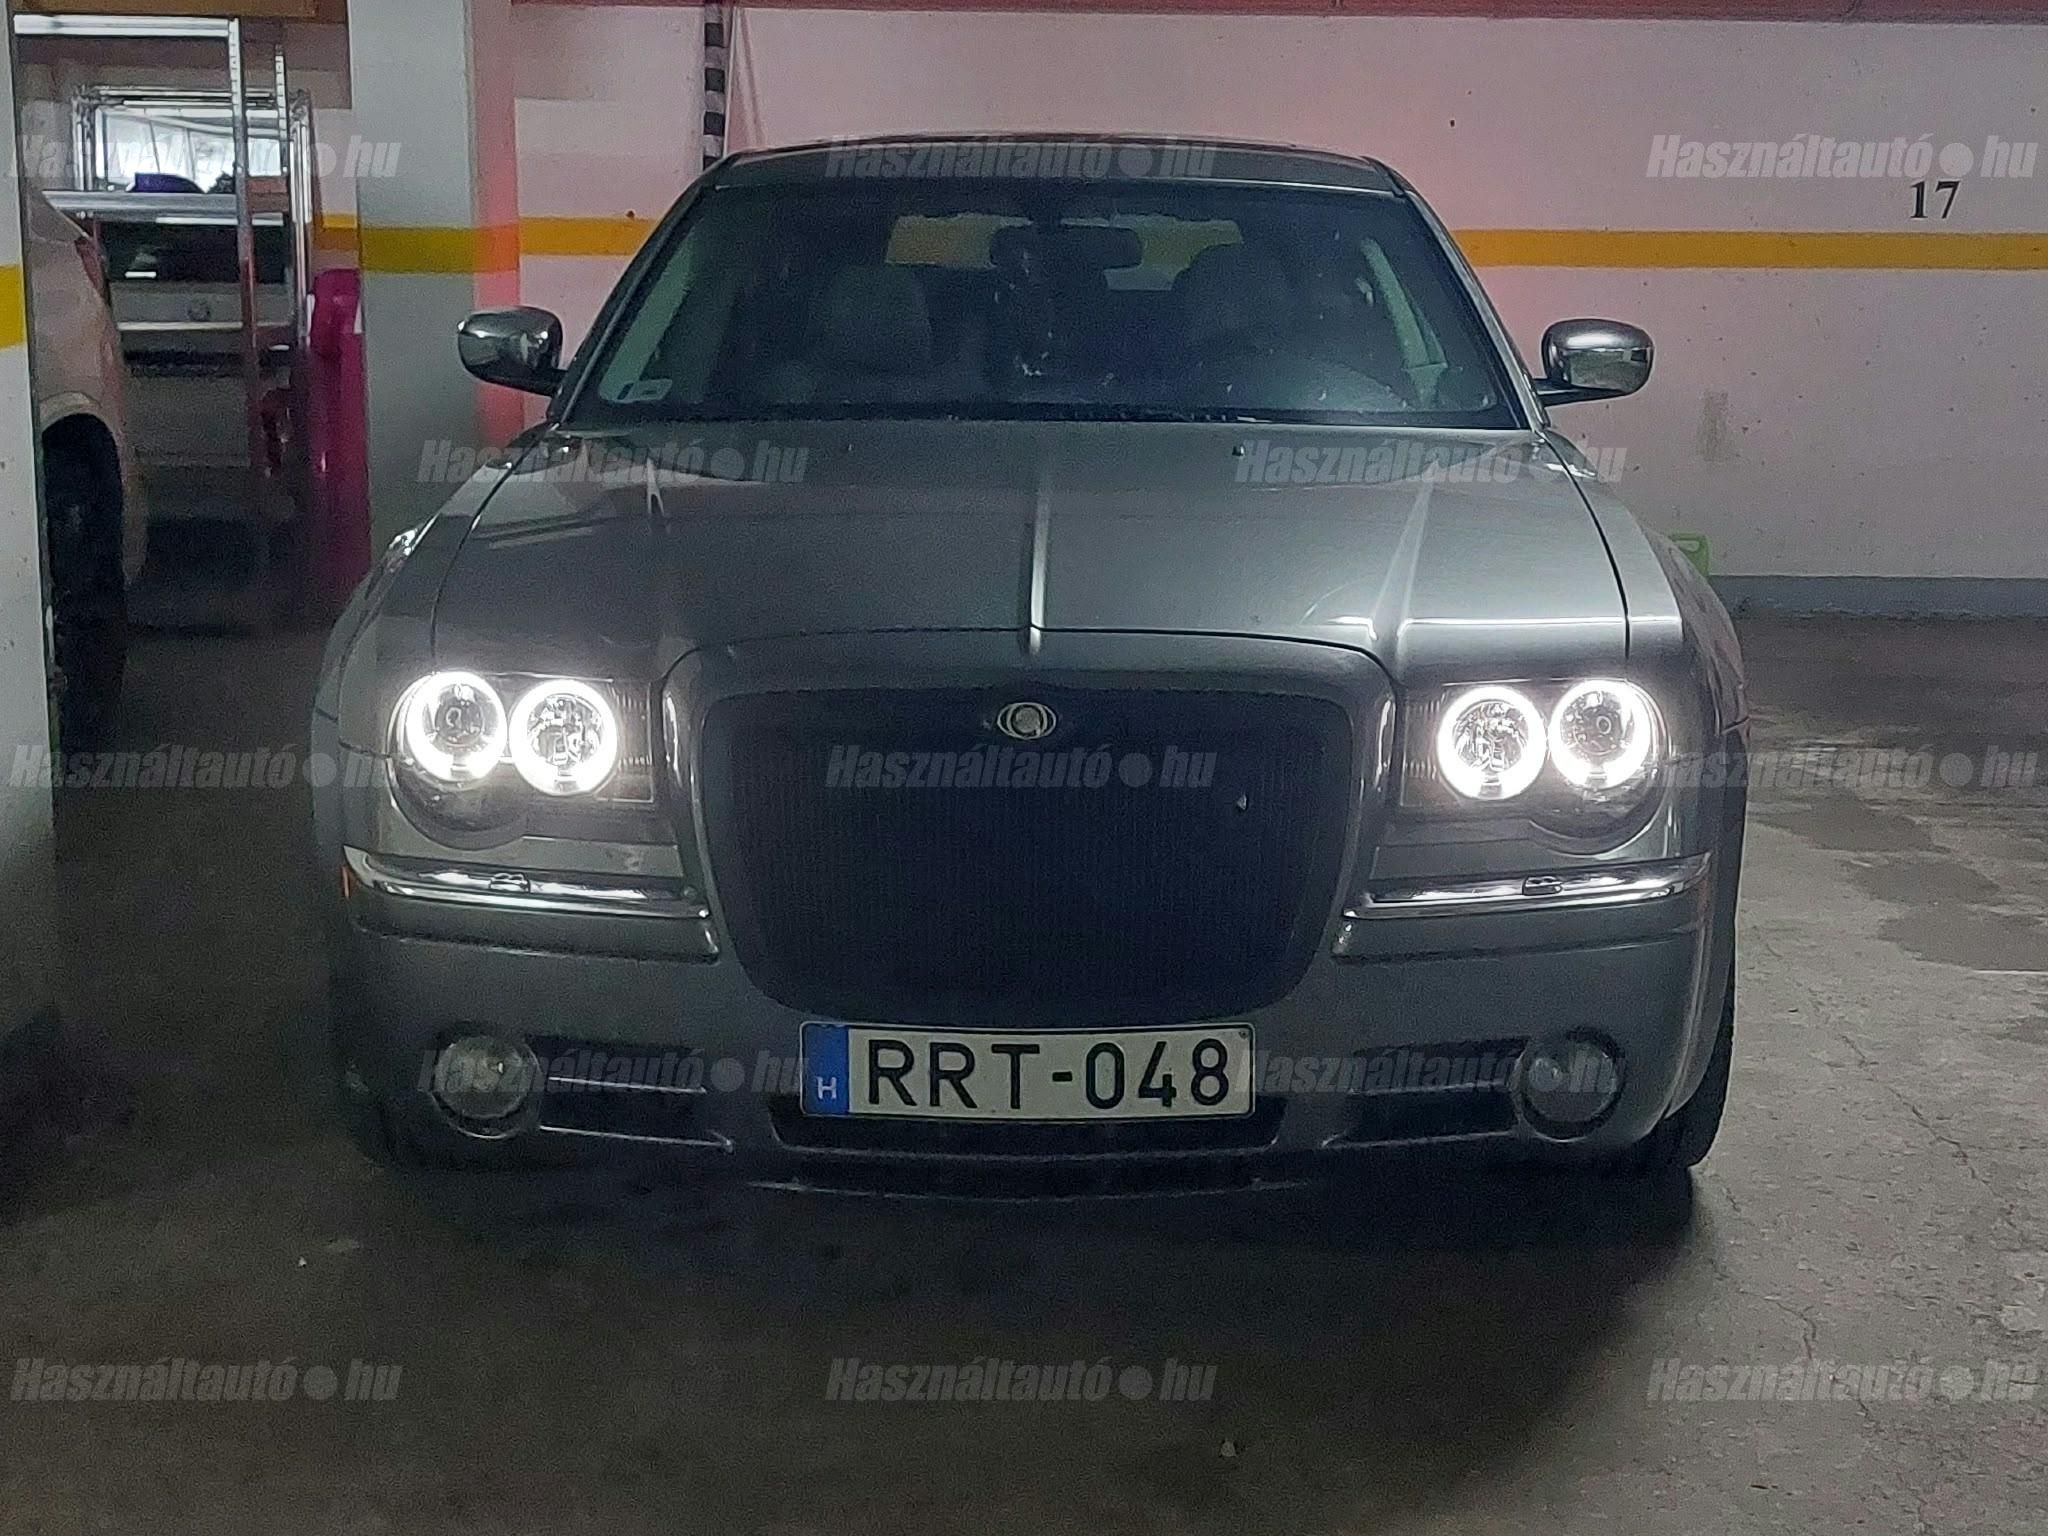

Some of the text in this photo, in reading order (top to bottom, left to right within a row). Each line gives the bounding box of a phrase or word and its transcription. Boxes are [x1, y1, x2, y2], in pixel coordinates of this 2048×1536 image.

[1910, 180, 1960, 219] 17
[816, 1077, 838, 1100] H
[867, 1039, 1229, 1109] RRT-048
